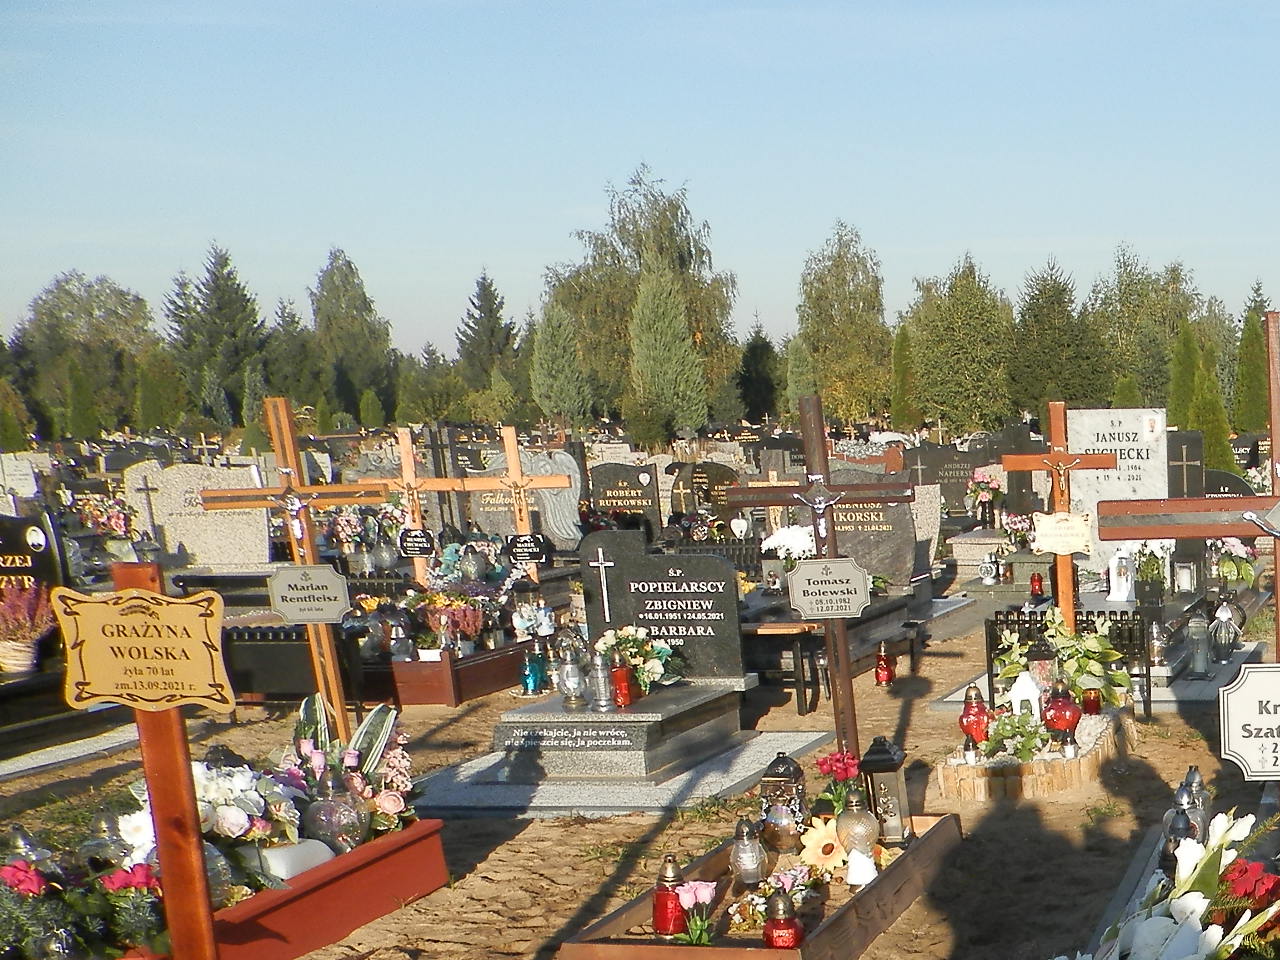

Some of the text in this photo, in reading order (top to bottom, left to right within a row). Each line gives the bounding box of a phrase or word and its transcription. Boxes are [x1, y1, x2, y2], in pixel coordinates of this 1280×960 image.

[1095, 432, 1139, 443] JANUSZ
[606, 489, 643, 497] ROBERT
[599, 499, 652, 507] RUTKOWSKI
[630, 581, 726, 593] POPIELARSCY
[806, 578, 851, 586] Tomasz
[287, 583, 329, 592] Marian
[802, 587, 858, 598] Bolewski
[645, 600, 714, 610] ZBIGNIEW
[101, 621, 193, 639] GRAŻYNA
[651, 626, 716, 636] BARBARA
[109, 645, 192, 661] WOLSKA
[122, 666, 175, 678] żyła 70 lat
[512, 729, 528, 737] Nie
[573, 729, 581, 738] ja
[587, 738, 633, 748] poczekam.
